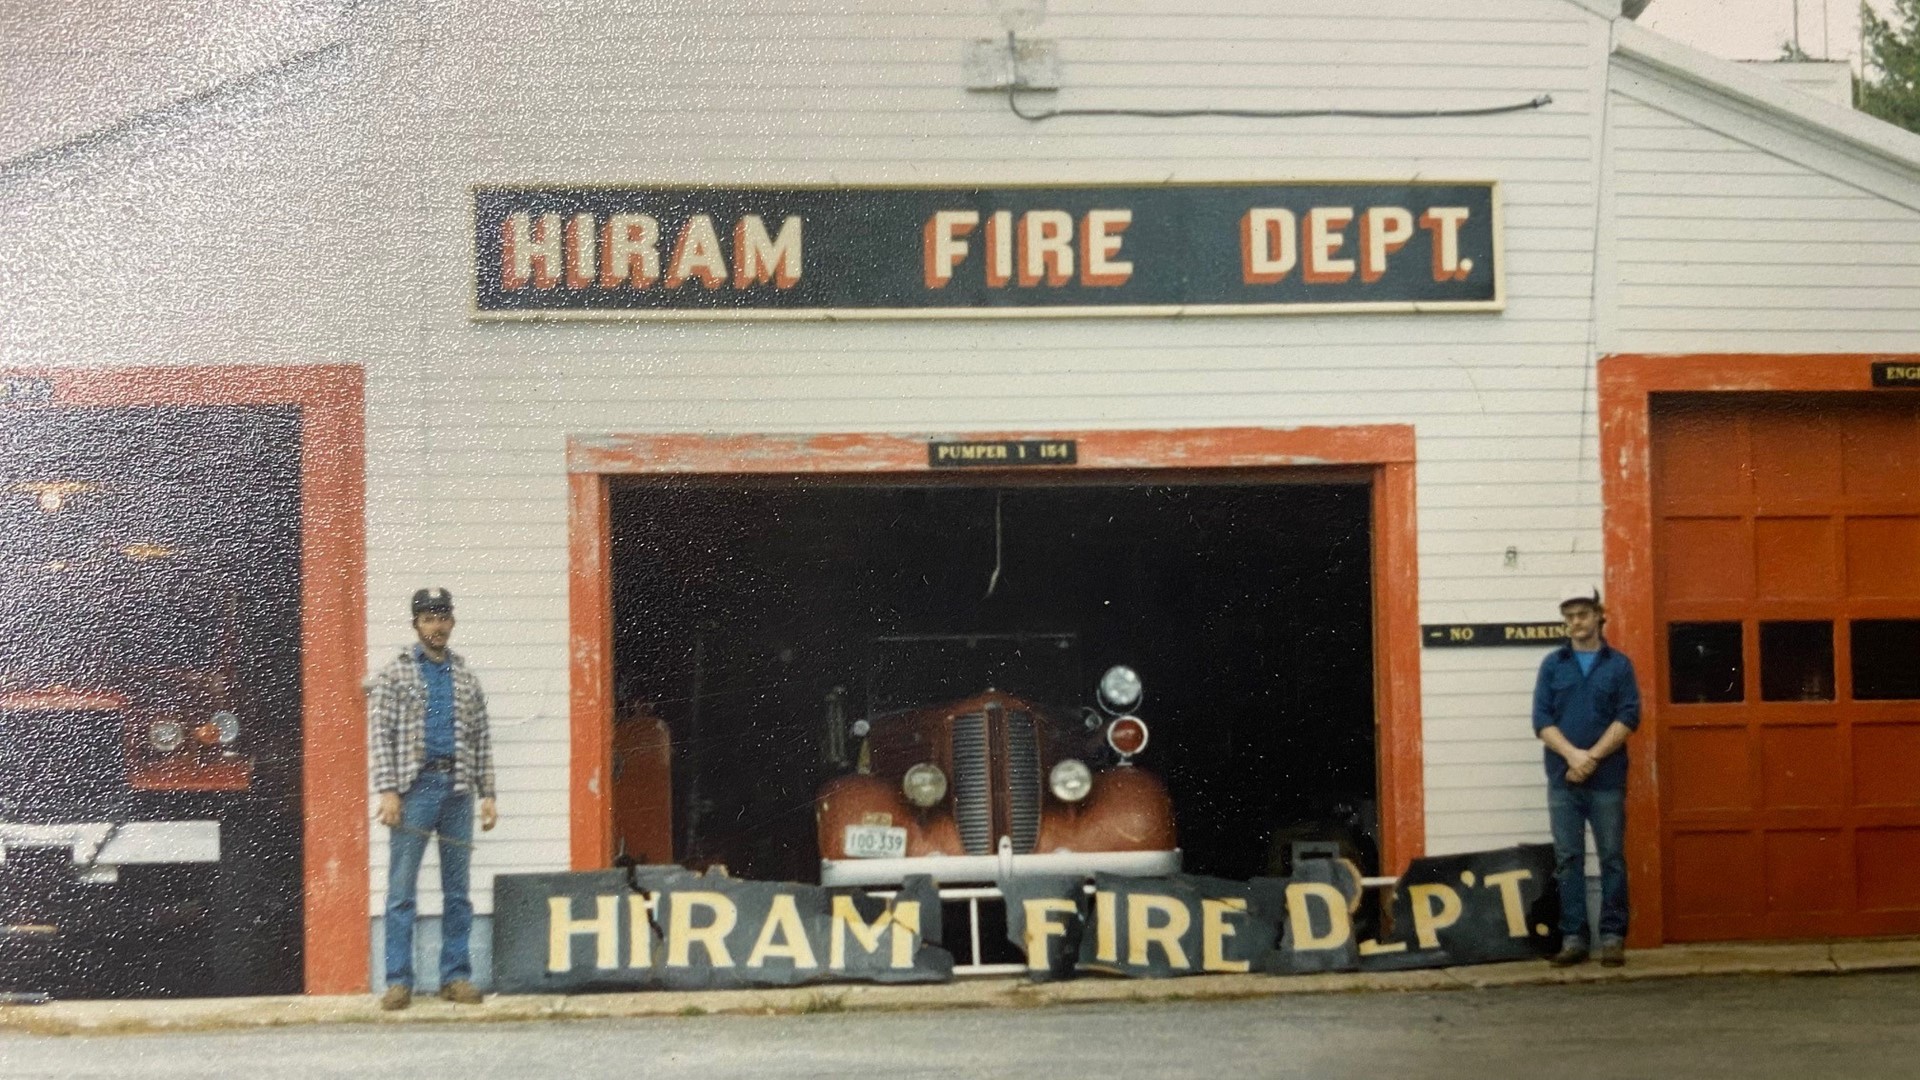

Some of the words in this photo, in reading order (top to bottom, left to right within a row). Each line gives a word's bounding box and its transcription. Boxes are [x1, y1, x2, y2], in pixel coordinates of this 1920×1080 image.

[503, 212, 802, 289] HIRAM
[923, 209, 1133, 288] FIRE
[1239, 206, 1474, 284] DEPT.
[938, 444, 1007, 460] PUMPER
[1450, 627, 1474, 641] NO
[547, 891, 921, 973] HIRAM
[1022, 890, 1250, 972] FIRE
